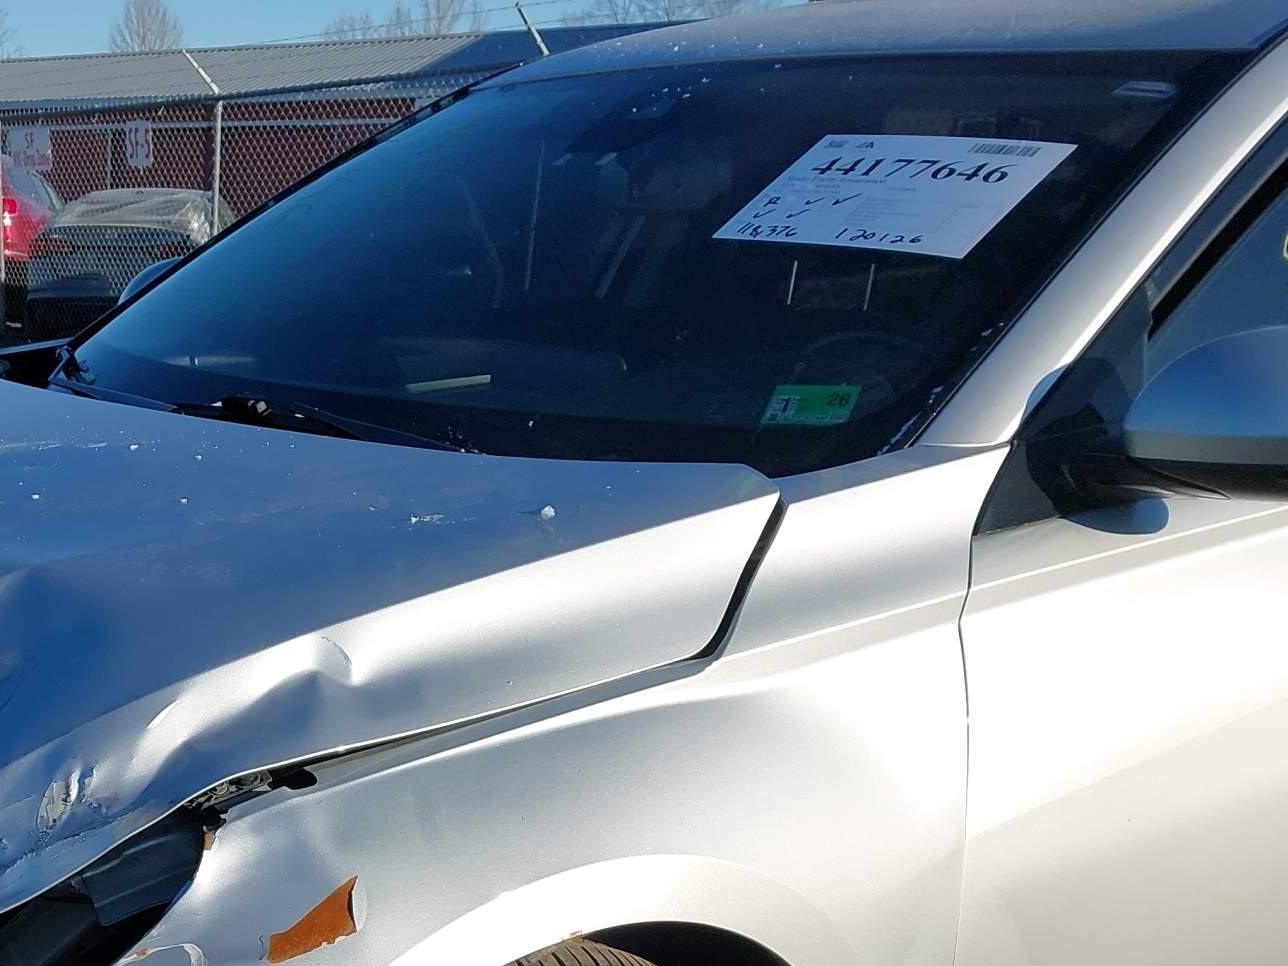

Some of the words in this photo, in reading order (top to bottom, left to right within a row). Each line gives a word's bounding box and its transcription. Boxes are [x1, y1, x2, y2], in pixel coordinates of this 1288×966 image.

[24, 132, 34, 150] SF
[128, 127, 151, 159] SF-5
[810, 156, 1018, 184] 44177646
